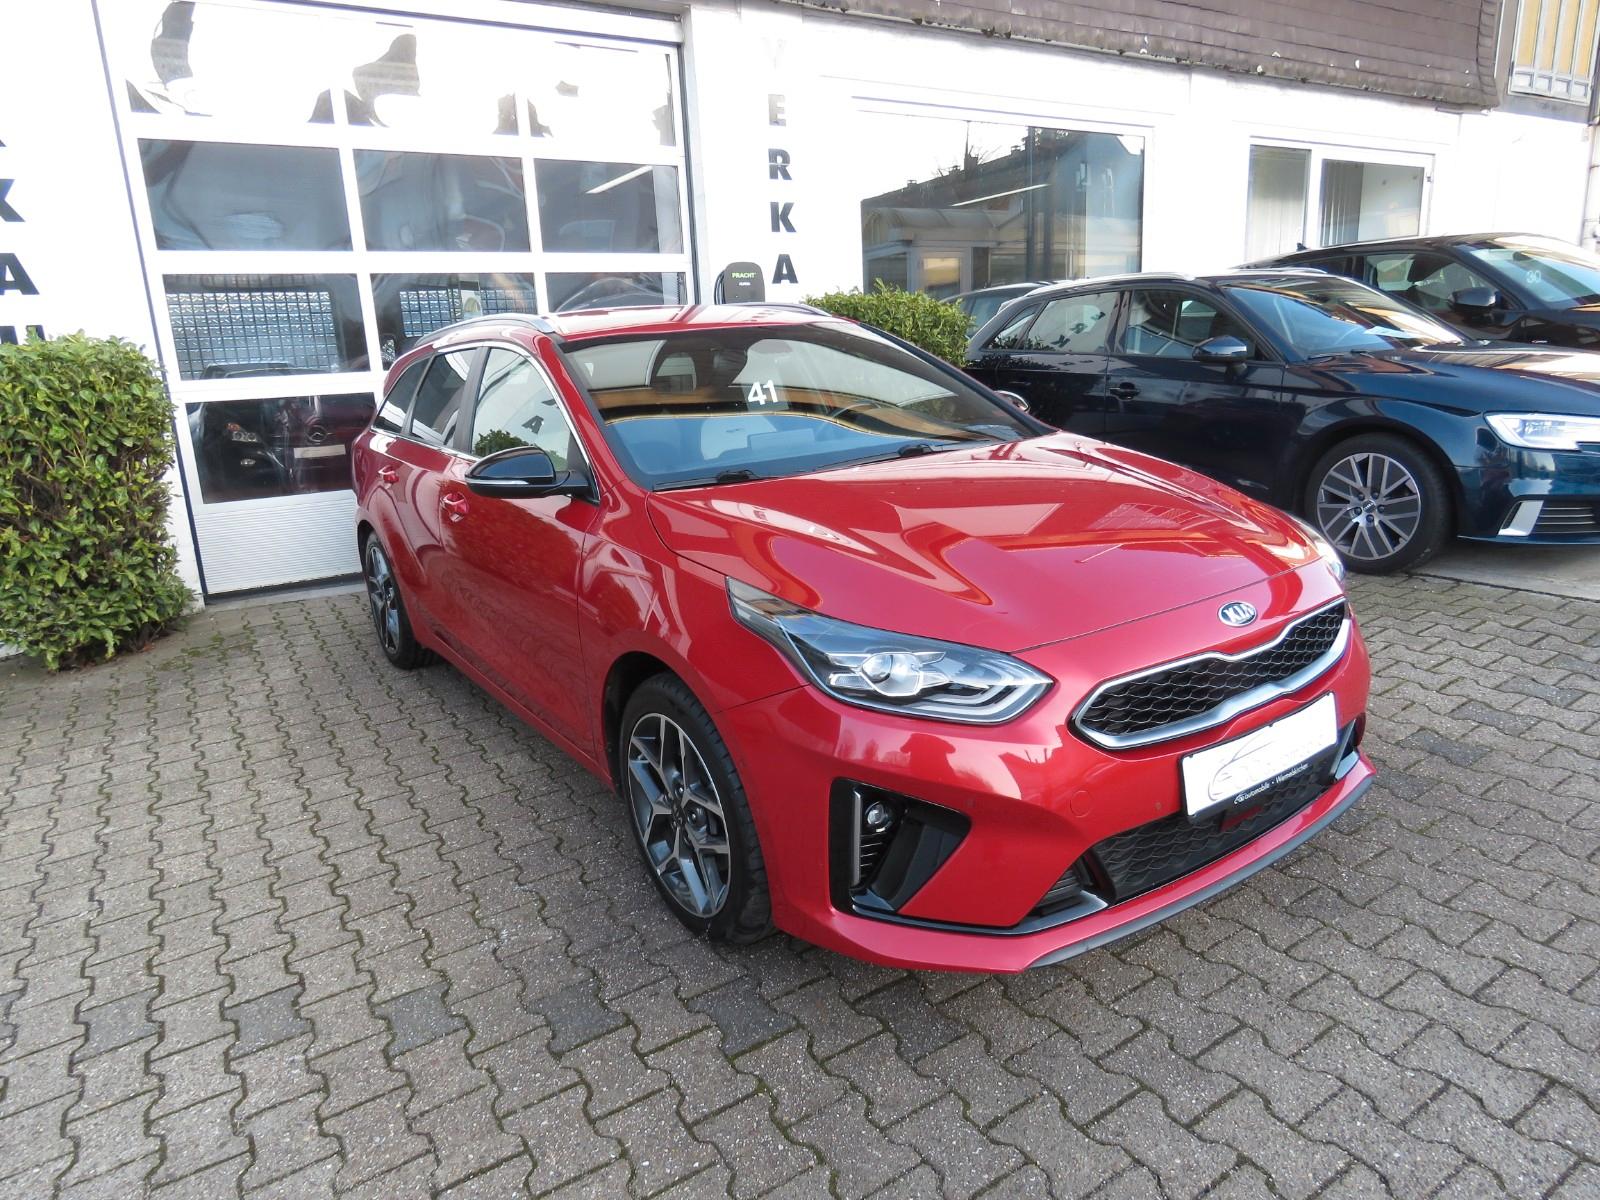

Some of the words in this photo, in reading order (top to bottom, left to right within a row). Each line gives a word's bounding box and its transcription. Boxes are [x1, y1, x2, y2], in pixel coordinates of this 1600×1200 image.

[1527, 270, 1542, 283] 30
[748, 380, 778, 405] 41
[1222, 603, 1255, 624] KIA
